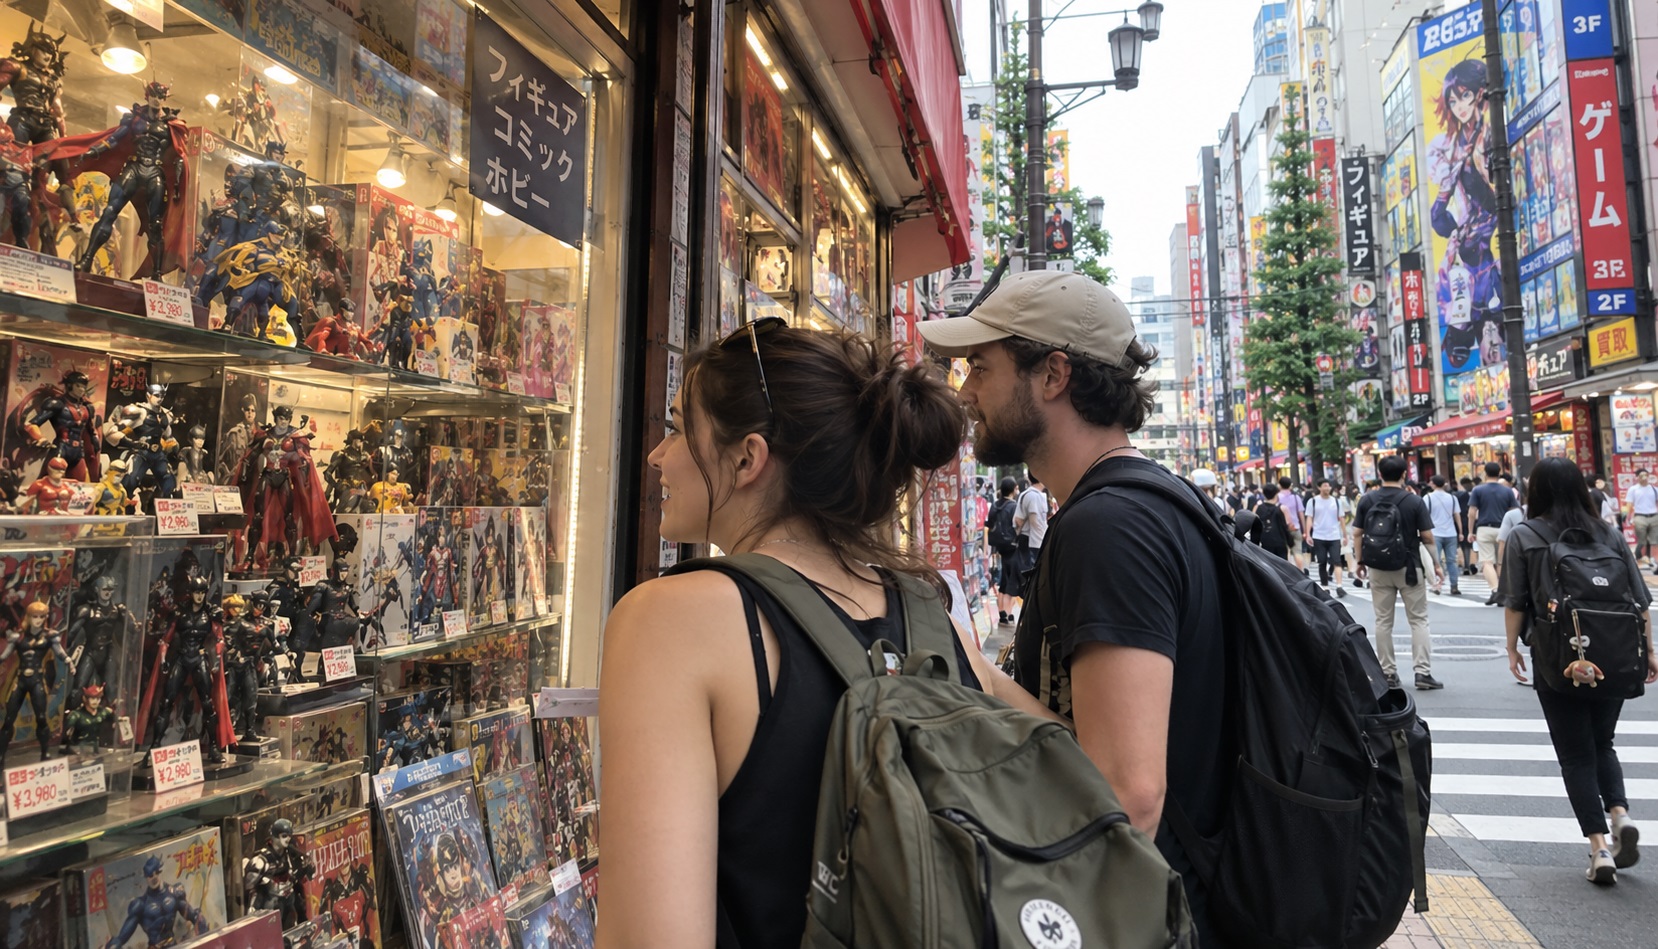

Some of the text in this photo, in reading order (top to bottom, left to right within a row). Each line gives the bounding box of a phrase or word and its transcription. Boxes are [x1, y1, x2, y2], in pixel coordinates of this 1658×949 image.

[1573, 15, 1602, 34] 3F
[488, 45, 578, 136] フィギュア
[494, 105, 574, 183] コミック
[1579, 100, 1622, 228] ゲーム
[486, 157, 550, 209] ホビー
[1347, 166, 1369, 266] フィギュア
[1597, 293, 1627, 311] 2F
[1597, 327, 1629, 358] 買取
[13, 784, 57, 810] ¥3,980
